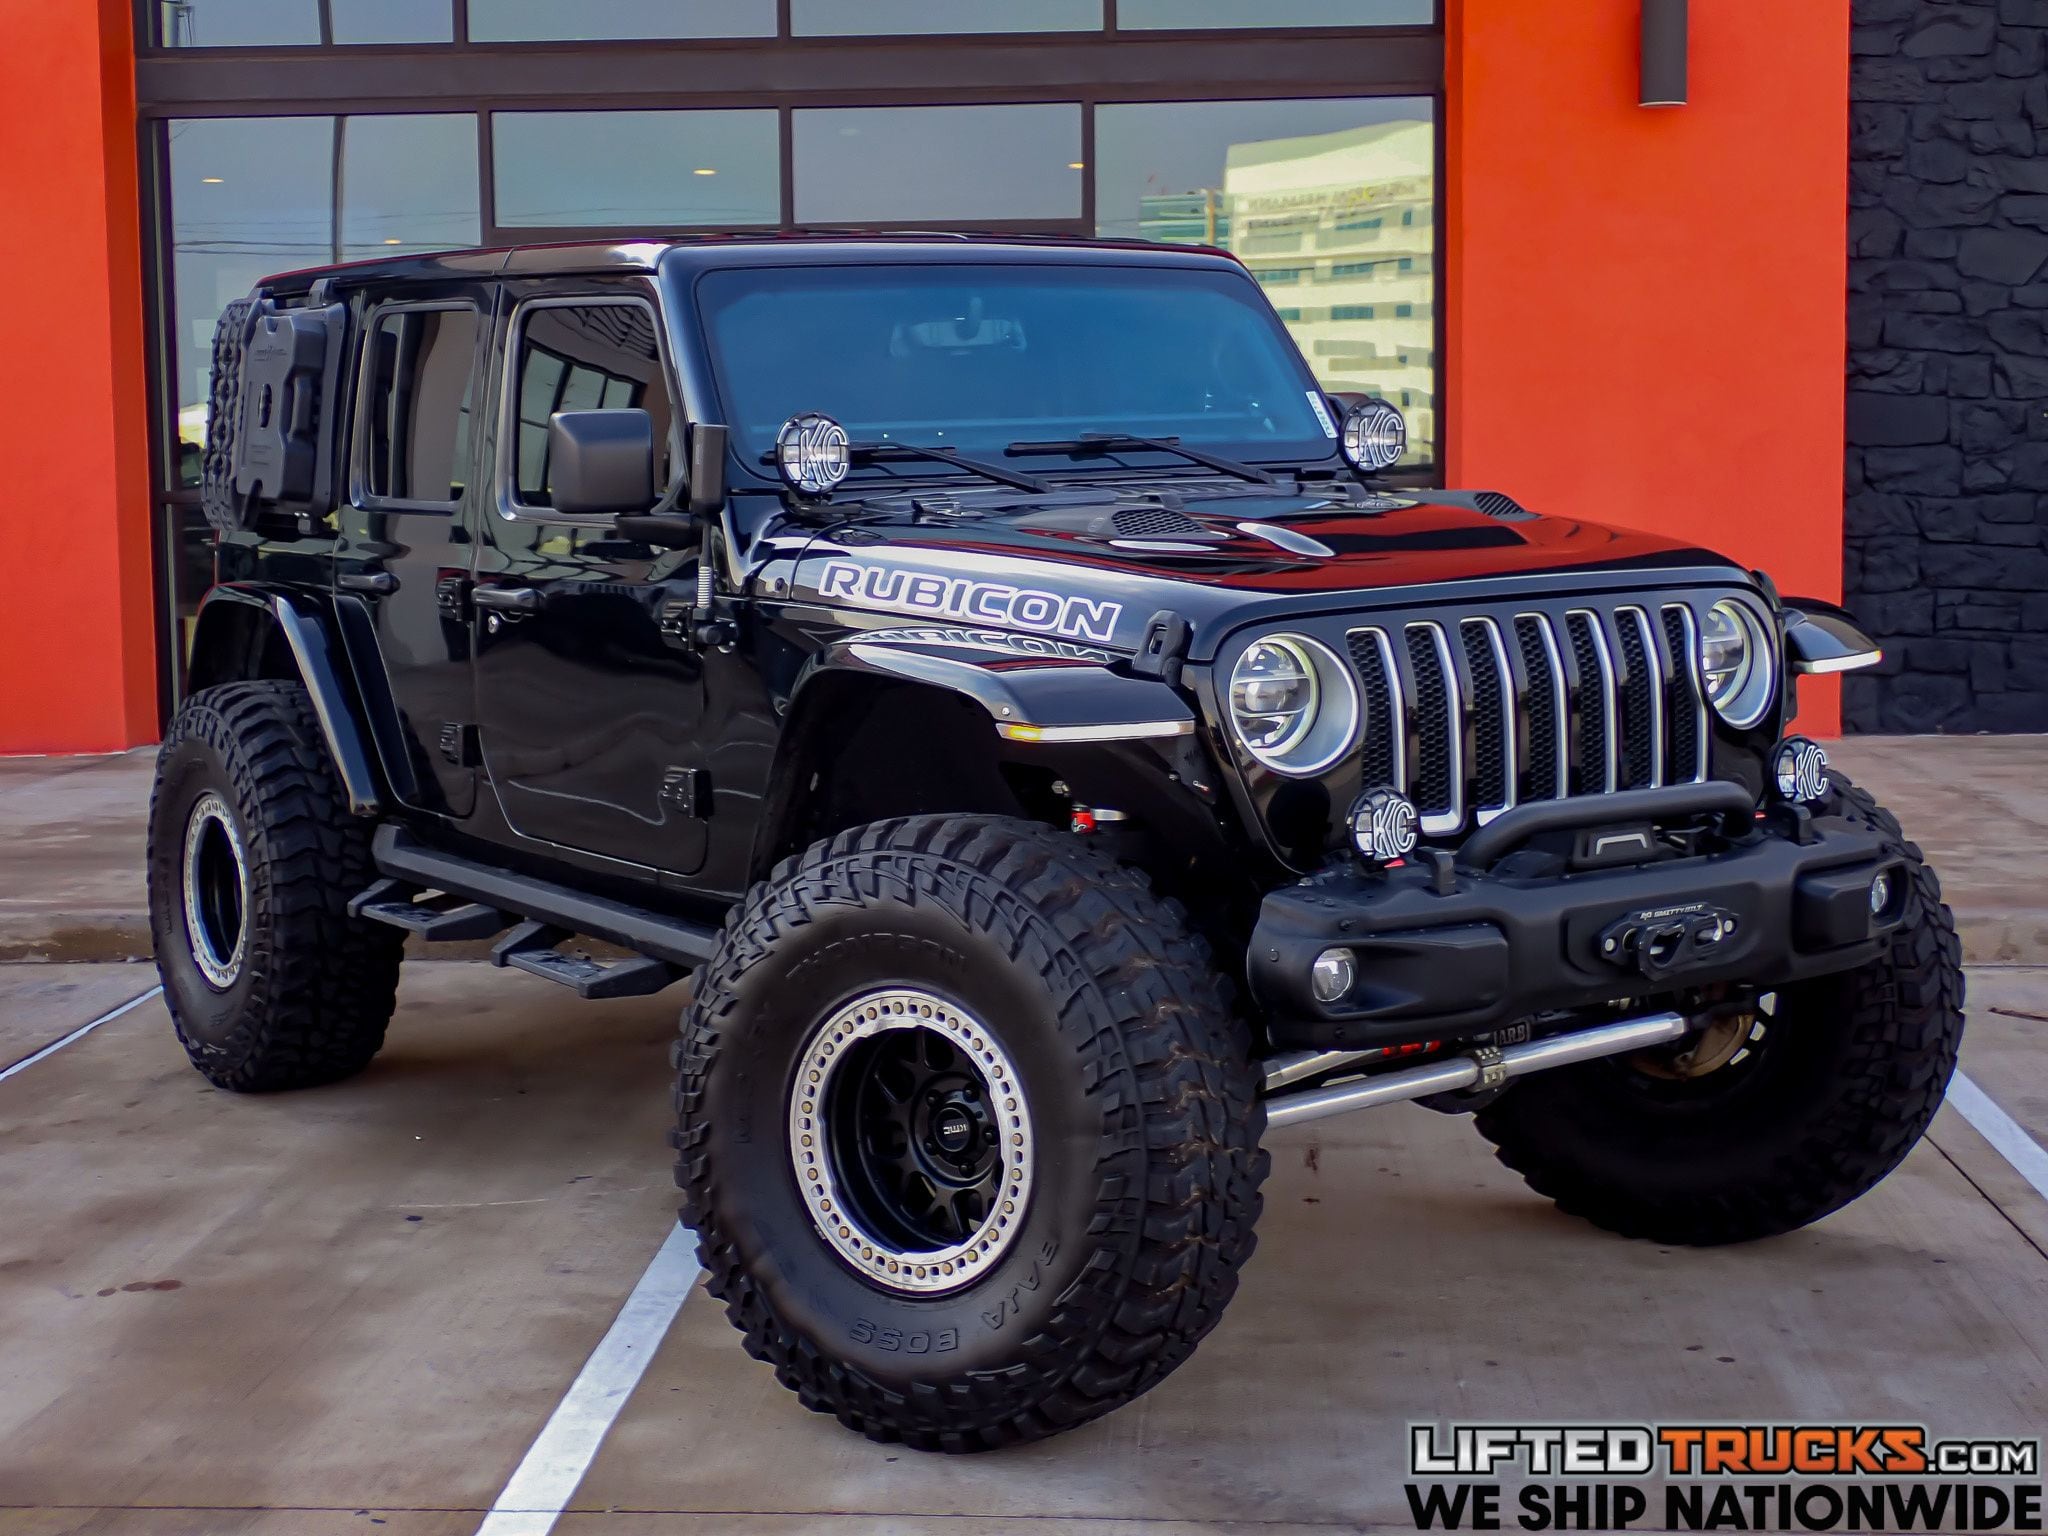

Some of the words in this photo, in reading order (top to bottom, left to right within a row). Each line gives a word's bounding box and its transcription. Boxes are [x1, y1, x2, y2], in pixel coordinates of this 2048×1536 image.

[800, 421, 848, 486] KC
[1359, 410, 1403, 467] KC
[818, 561, 1123, 642] RUBICON
[1796, 745, 1828, 800] KC
[1373, 799, 1416, 858] KC
[1500, 1024, 1526, 1046] ARB
[980, 1239, 1061, 1330] BAJA
[849, 1316, 959, 1354] BOSS
